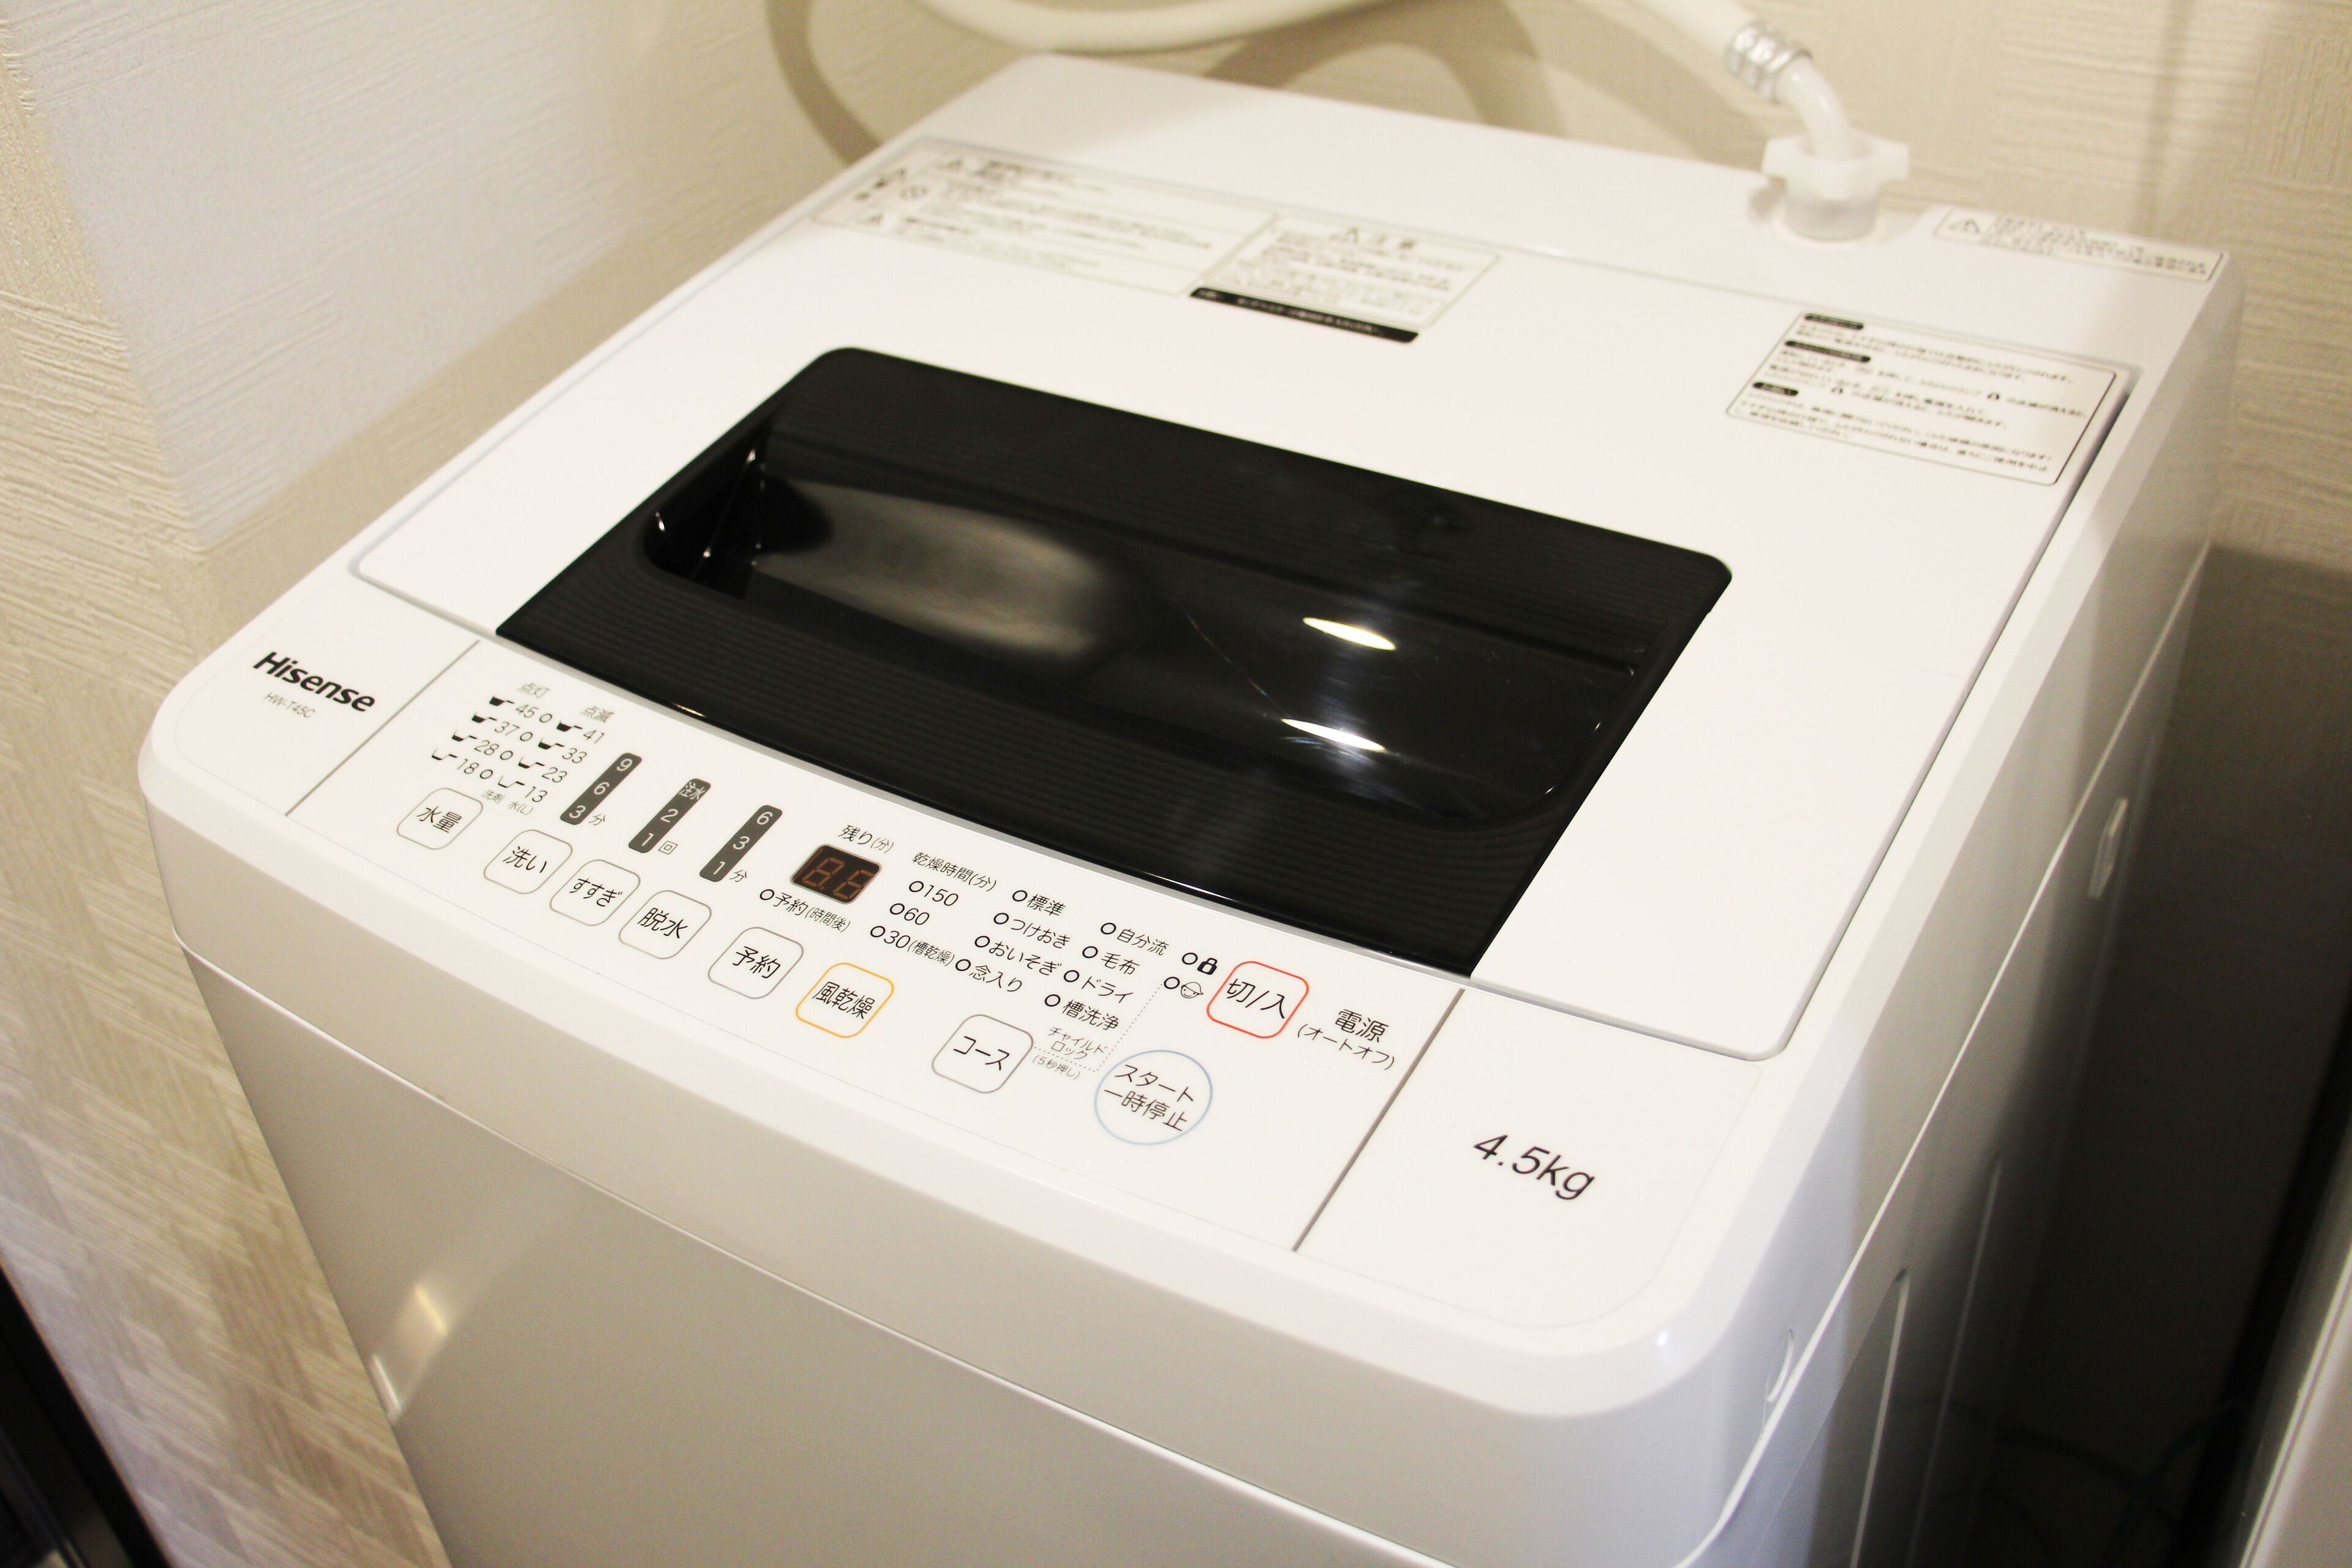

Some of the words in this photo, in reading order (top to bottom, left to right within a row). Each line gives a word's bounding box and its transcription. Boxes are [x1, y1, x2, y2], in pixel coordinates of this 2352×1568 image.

[253, 651, 375, 712] Hisense
[518, 682, 550, 698] 点灯
[263, 692, 316, 719] HW-T45C
[516, 704, 538, 718] 45
[494, 722, 520, 736] 37
[582, 729, 605, 744] 41
[474, 740, 499, 755] 28
[562, 748, 587, 764] 33
[458, 758, 480, 774] 18
[542, 767, 567, 783] 23
[616, 758, 633, 772] 9
[525, 786, 548, 802] 13
[594, 782, 609, 795] 6
[679, 781, 704, 801] 注水
[417, 805, 462, 833] 水量
[569, 805, 586, 818] 3
[589, 813, 606, 826] 分
[660, 809, 678, 823] 2
[756, 812, 774, 825] 6
[641, 833, 654, 846] 1
[658, 840, 678, 854] 回
[733, 837, 750, 850] 3
[502, 846, 547, 873] 洗い
[713, 861, 725, 875] 1
[729, 869, 748, 883] 分
[570, 878, 622, 907] すすぎ
[924, 884, 959, 907] 150
[904, 908, 930, 925] 60
[1027, 894, 1066, 916] 標準
[638, 908, 688, 938] 脱水
[1011, 918, 1070, 948] つけおき
[1117, 929, 1169, 956] 自分流
[733, 946, 780, 979] 予約
[989, 941, 1062, 976] おいそぎ
[1101, 952, 1140, 976] 毛布
[969, 965, 1022, 993] 念入り
[1082, 977, 1133, 1004] ドライ
[813, 982, 875, 1019] 風乾燥
[1226, 979, 1286, 1019] 切/入
[1063, 1000, 1120, 1031] 槽洗浄
[1334, 1009, 1389, 1043] 電源
[1047, 1027, 1107, 1054] チャイルド
[1051, 1041, 1088, 1061] ロック
[1297, 1024, 1395, 1070] (オートオフ)
[953, 1036, 1009, 1071] コース
[1033, 1055, 1082, 1080] (5秒押し)
[1115, 1065, 1194, 1102] スタート
[1104, 1088, 1189, 1132] 一時停止
[1474, 1134, 1594, 1200] 4.5kg
